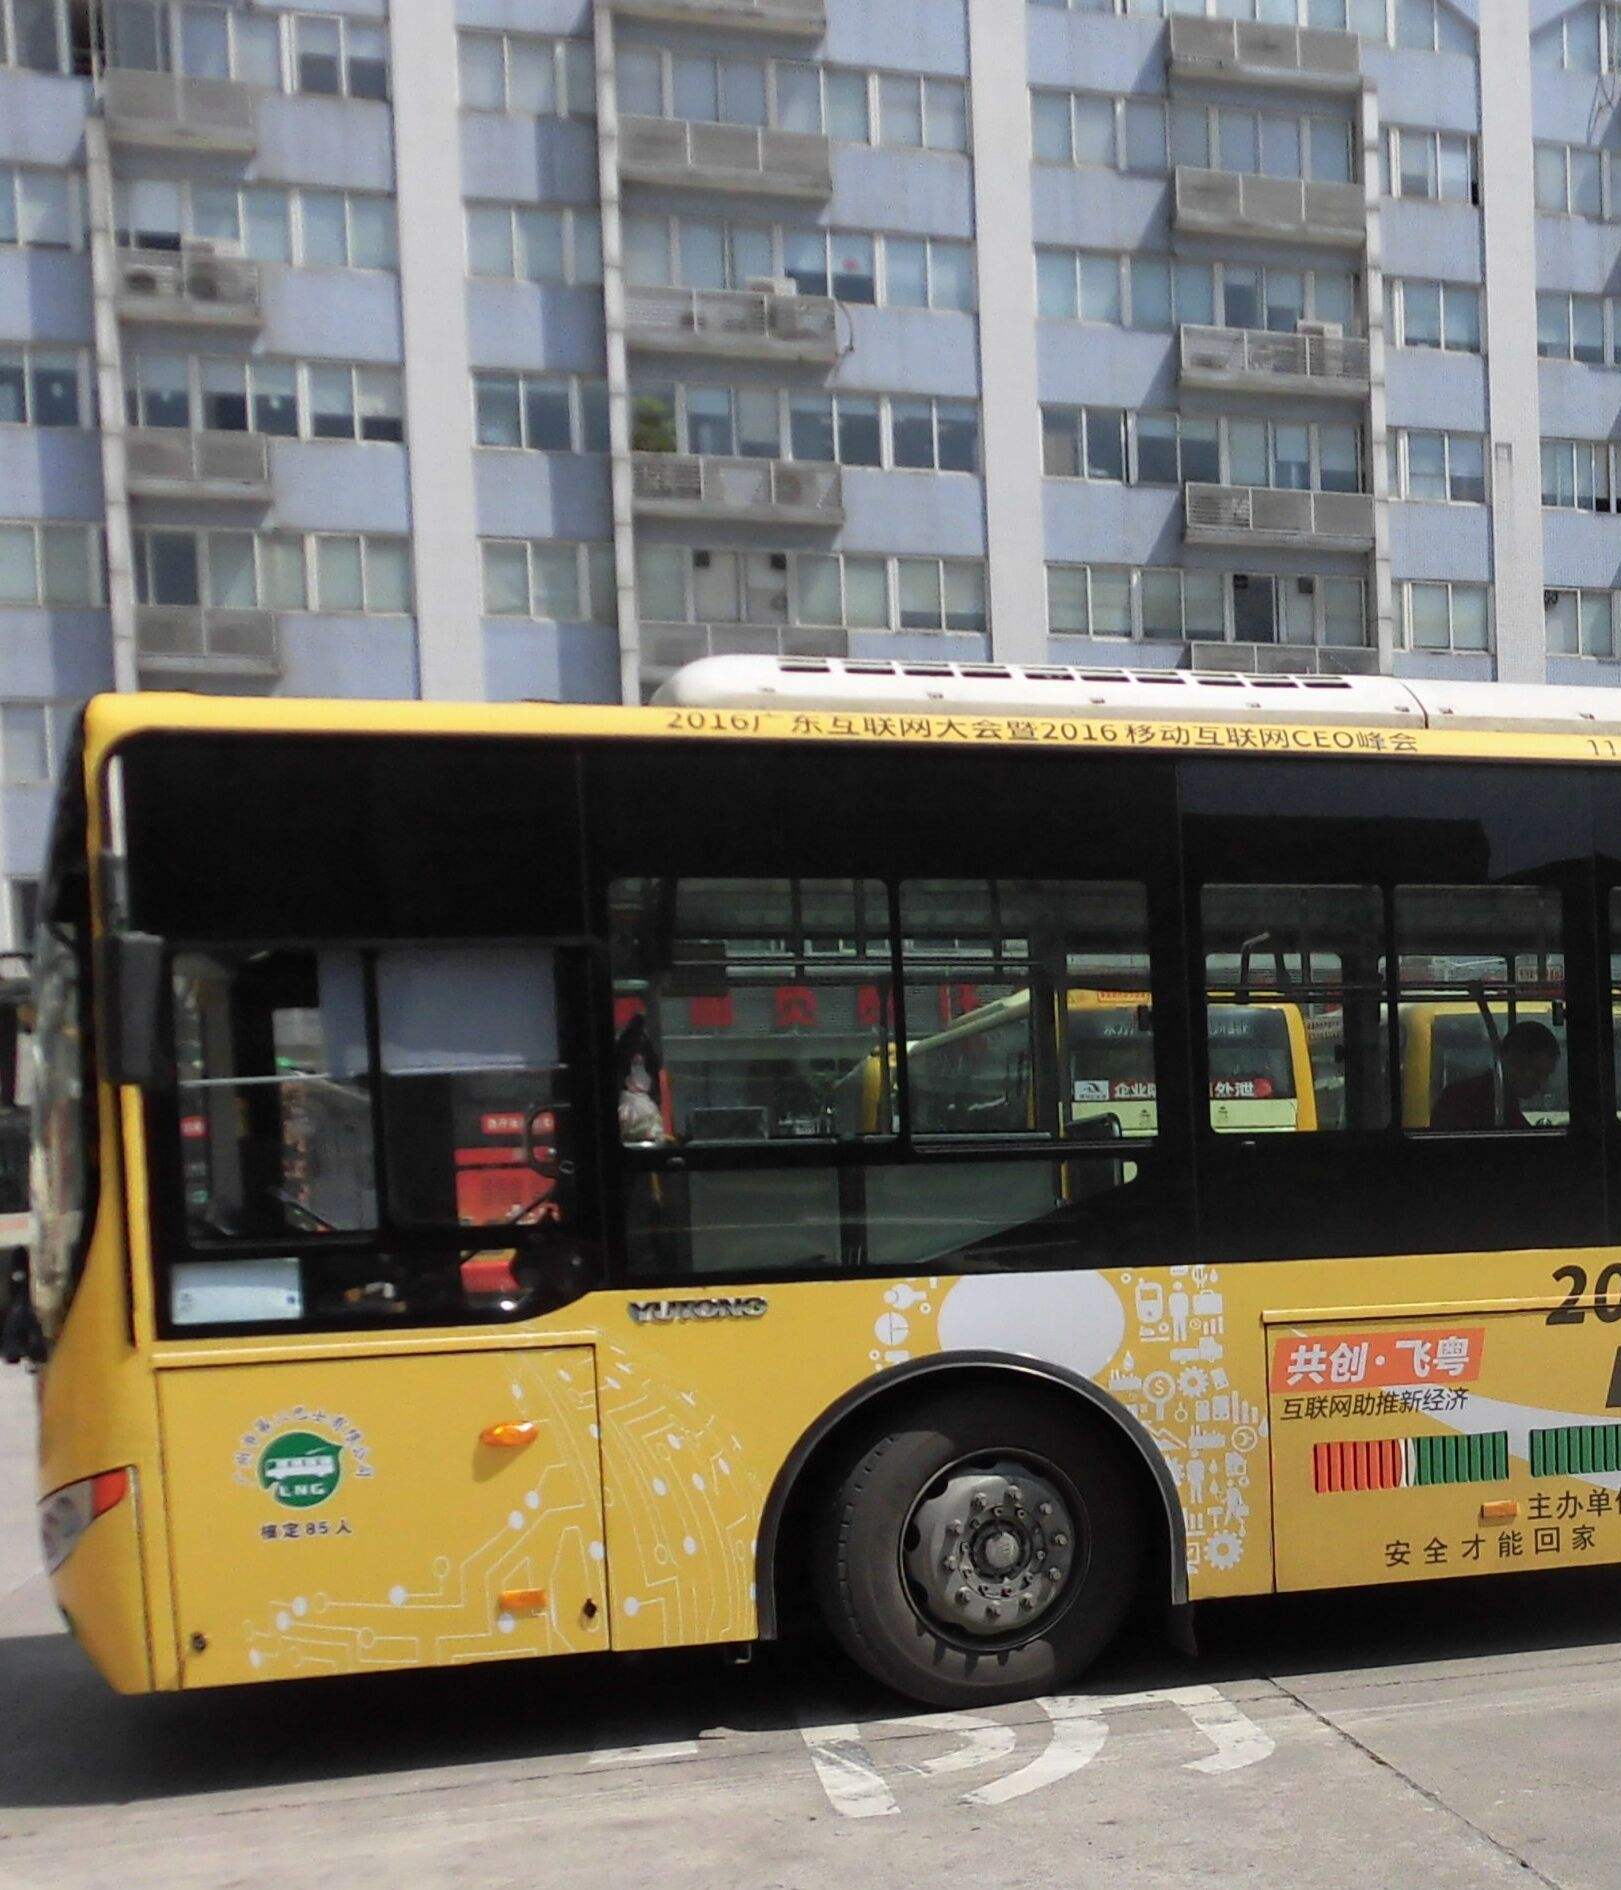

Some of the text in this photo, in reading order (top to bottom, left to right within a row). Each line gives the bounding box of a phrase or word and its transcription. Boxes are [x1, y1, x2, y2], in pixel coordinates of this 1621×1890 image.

[629, 1297, 768, 1324] YUTONG
[1280, 1387, 1470, 1421] 互联网助推新经济
[278, 1483, 326, 1498] LNG
[1385, 1525, 1597, 1568] 安全才能回家
